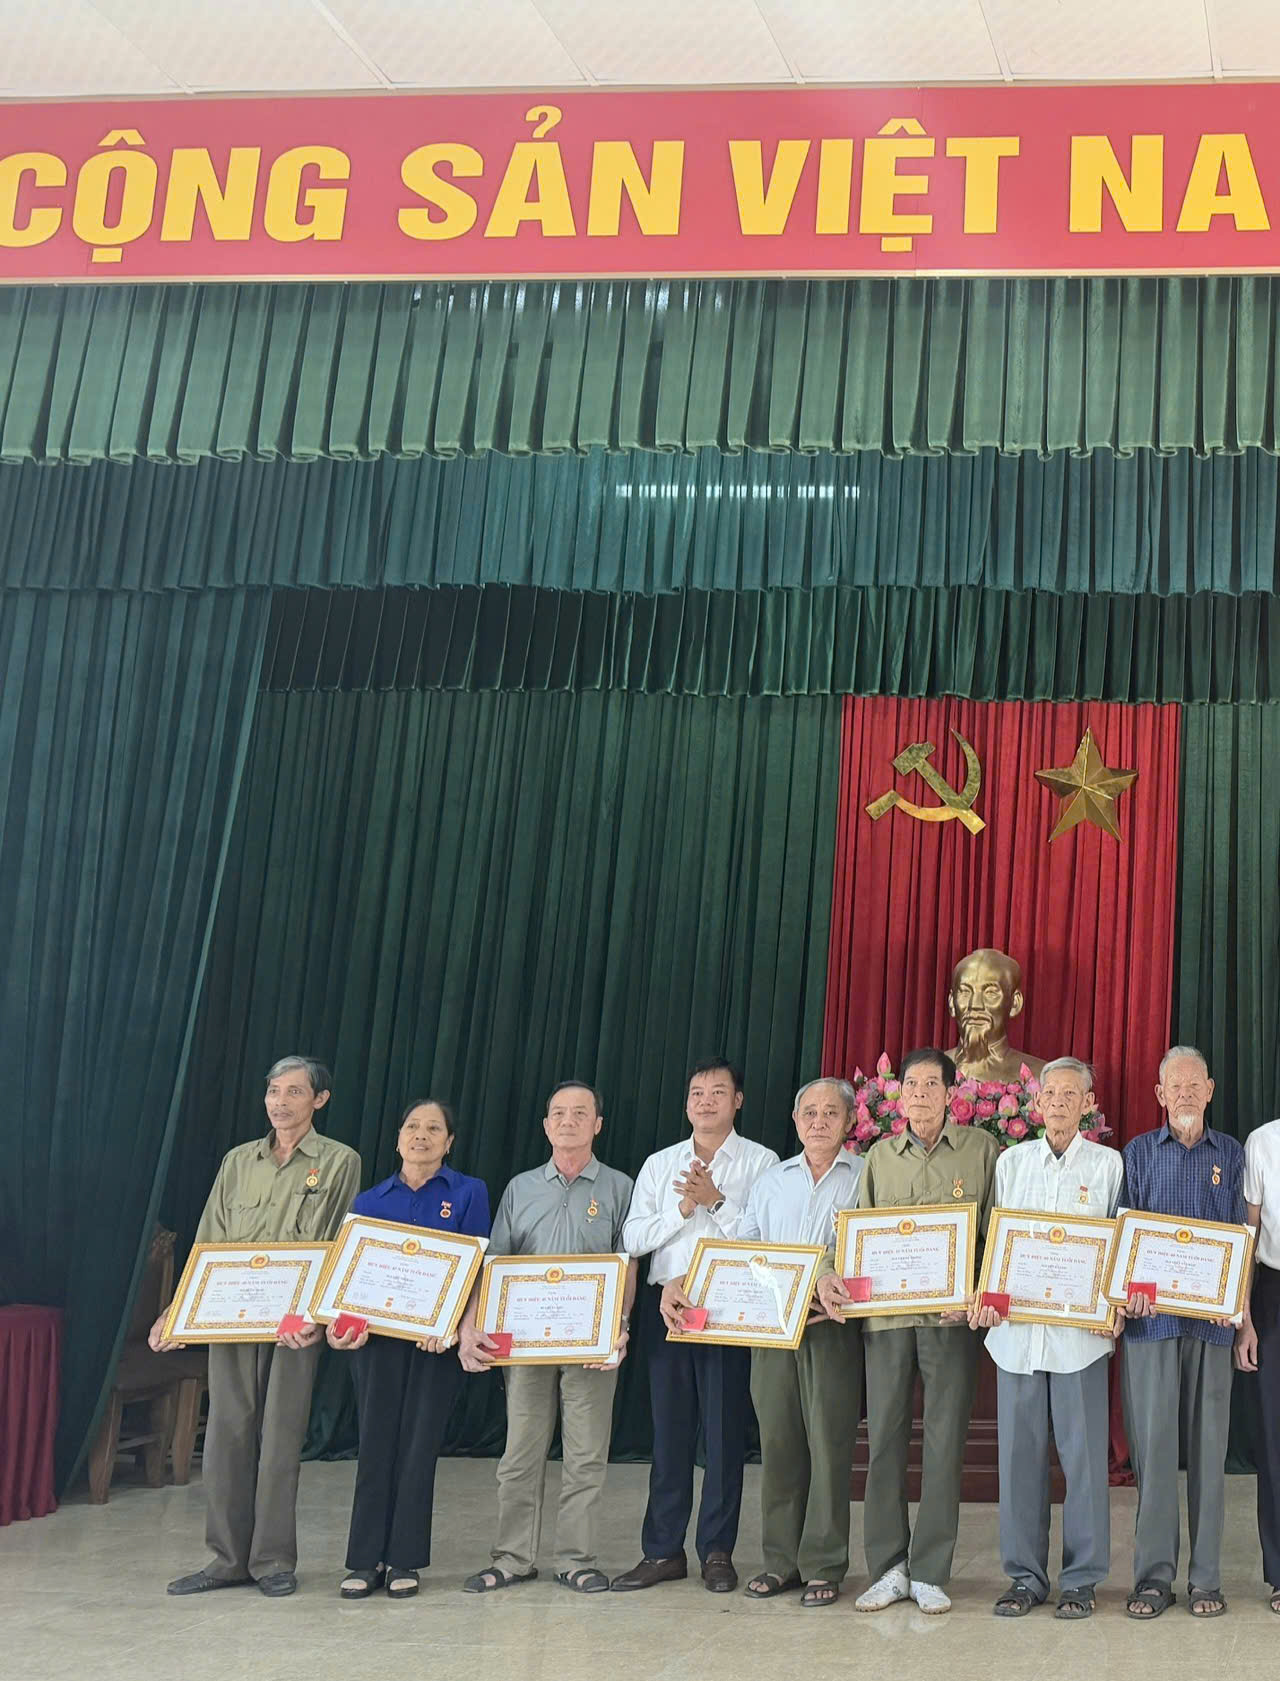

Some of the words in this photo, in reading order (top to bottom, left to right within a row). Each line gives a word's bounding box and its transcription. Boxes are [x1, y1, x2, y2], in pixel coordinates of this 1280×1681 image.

[0, 129, 351, 263] CỘNG
[398, 105, 685, 240] SẢN
[729, 118, 1020, 253] VIỆT
